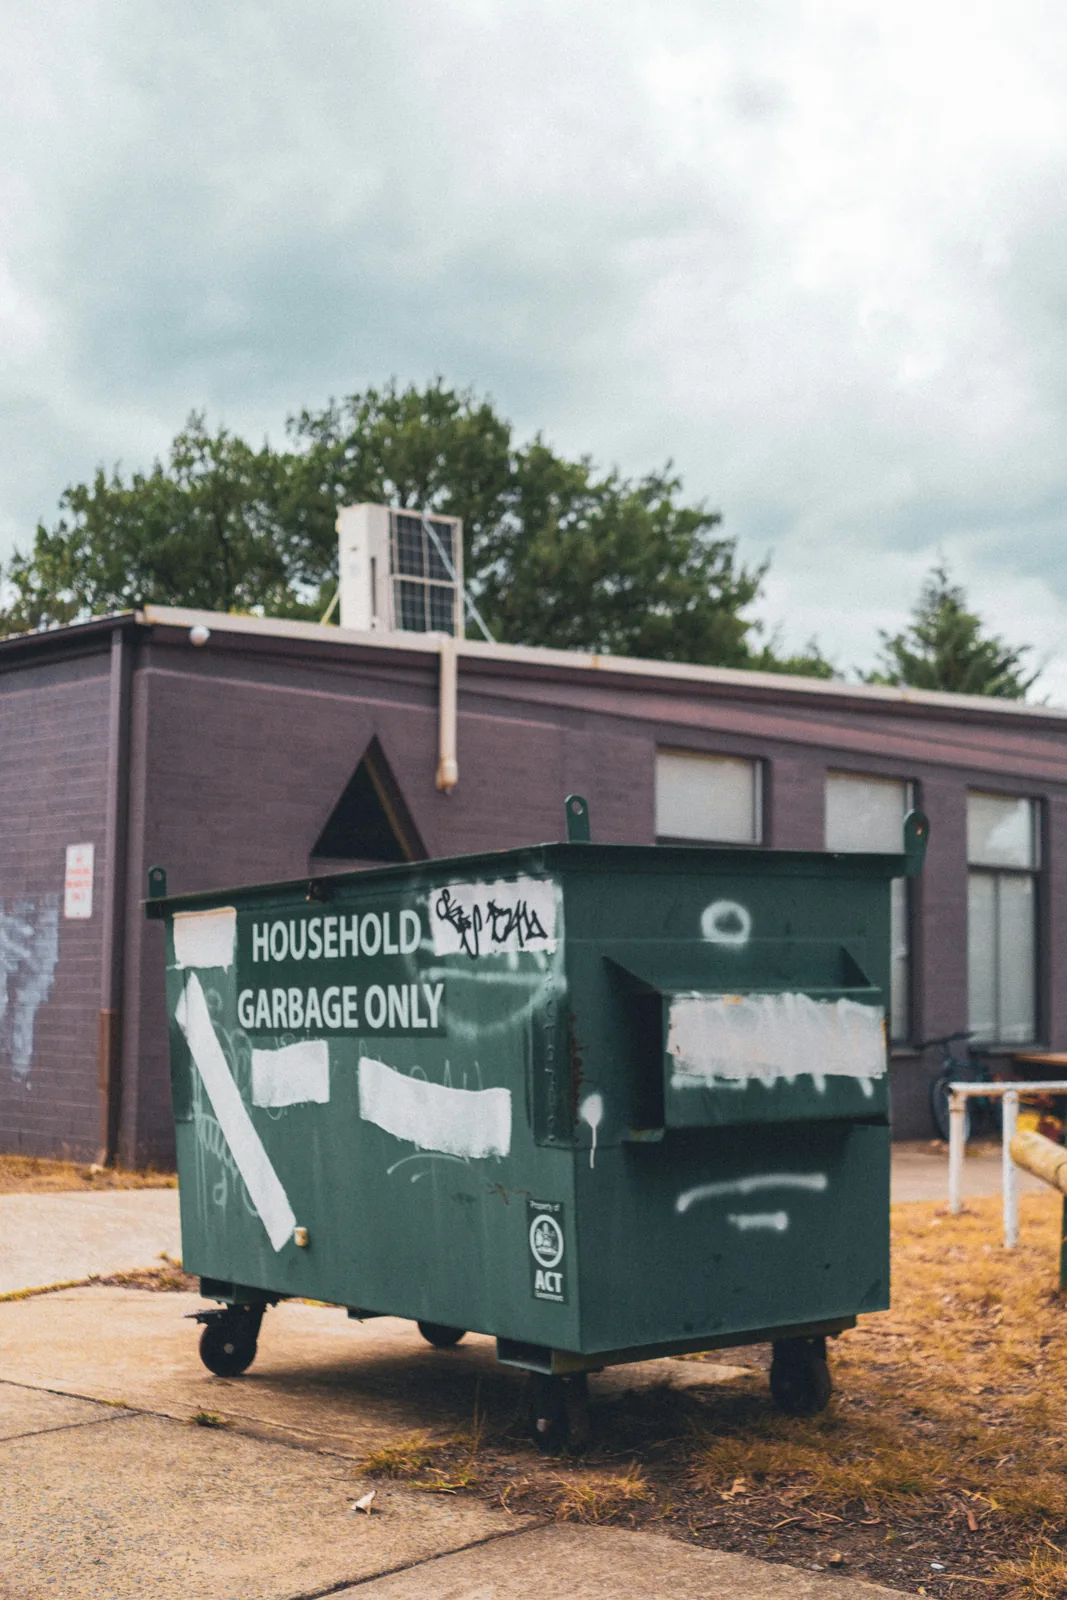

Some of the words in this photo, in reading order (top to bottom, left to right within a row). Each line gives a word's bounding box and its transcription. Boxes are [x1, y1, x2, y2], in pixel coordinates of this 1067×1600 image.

[252, 910, 422, 963] HOUSEHOLD
[237, 986, 359, 1029] GARBAGE
[364, 983, 444, 1029] ONLY
[534, 1269, 563, 1293] ACT
